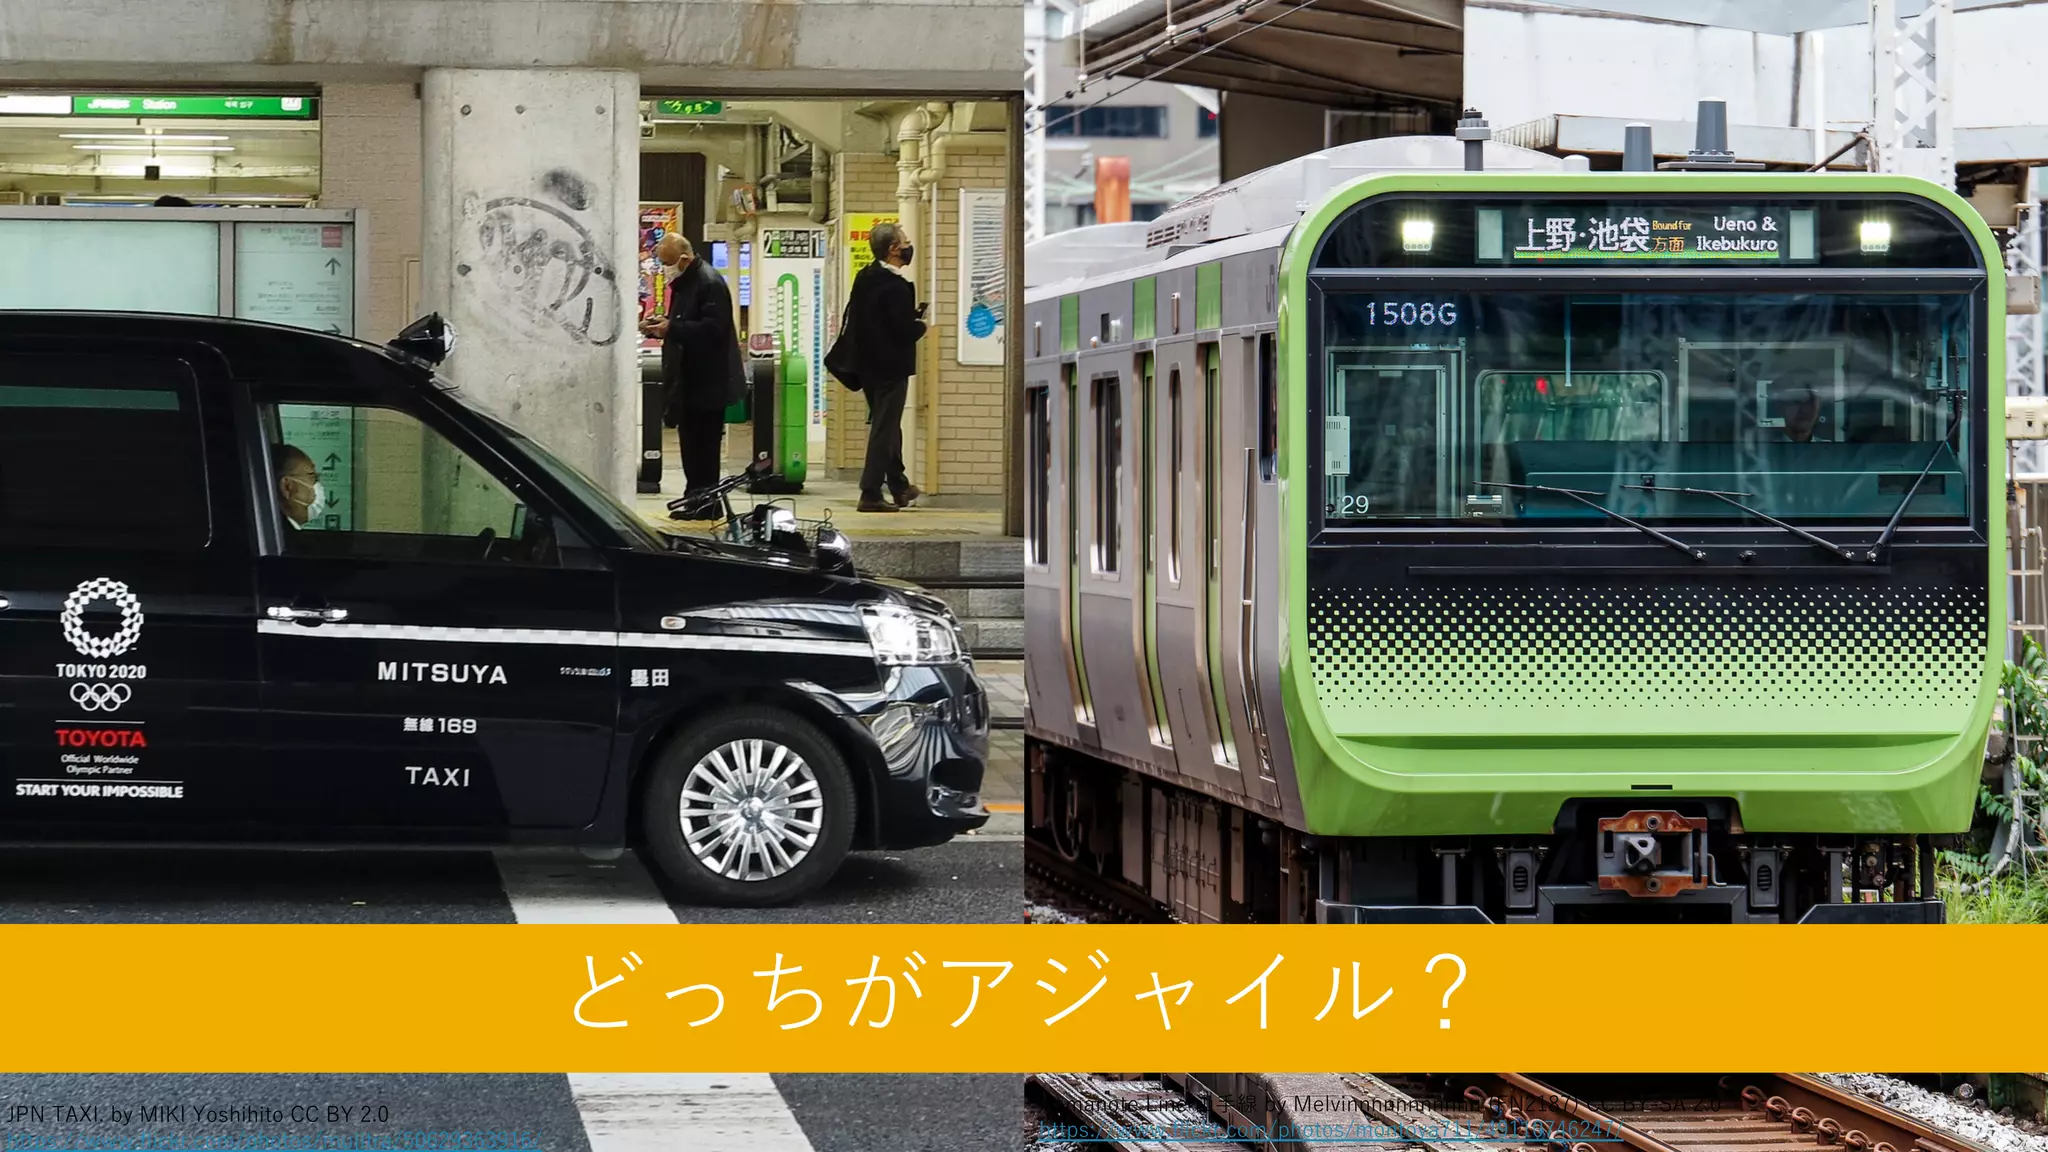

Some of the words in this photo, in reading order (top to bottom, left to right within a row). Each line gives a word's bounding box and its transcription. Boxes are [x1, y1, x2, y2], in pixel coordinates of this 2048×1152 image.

[1652, 220, 1678, 231] Bound
[1678, 220, 1693, 231] for
[1713, 216, 1757, 232] Ueno
[1763, 216, 1779, 232] &
[1651, 236, 1686, 252] 方面
[1696, 235, 1779, 252] Ikebukuro
[1366, 302, 1457, 326] 1508G
[1341, 495, 1370, 514] 29
[56, 663, 107, 678] TOKYO
[109, 664, 147, 679] 2020
[378, 661, 508, 684] MITSUYA
[629, 668, 670, 687] 墨田
[56, 729, 147, 747] TOYOTA
[60, 754, 91, 764] Official
[93, 754, 140, 765] Worldwide
[66, 764, 101, 776] Olympic
[102, 765, 134, 775] Partner
[405, 766, 470, 787] TAXI
[16, 783, 59, 796] START
[61, 784, 101, 797] YOUR
[102, 785, 184, 798] IMPOSSIBLE
